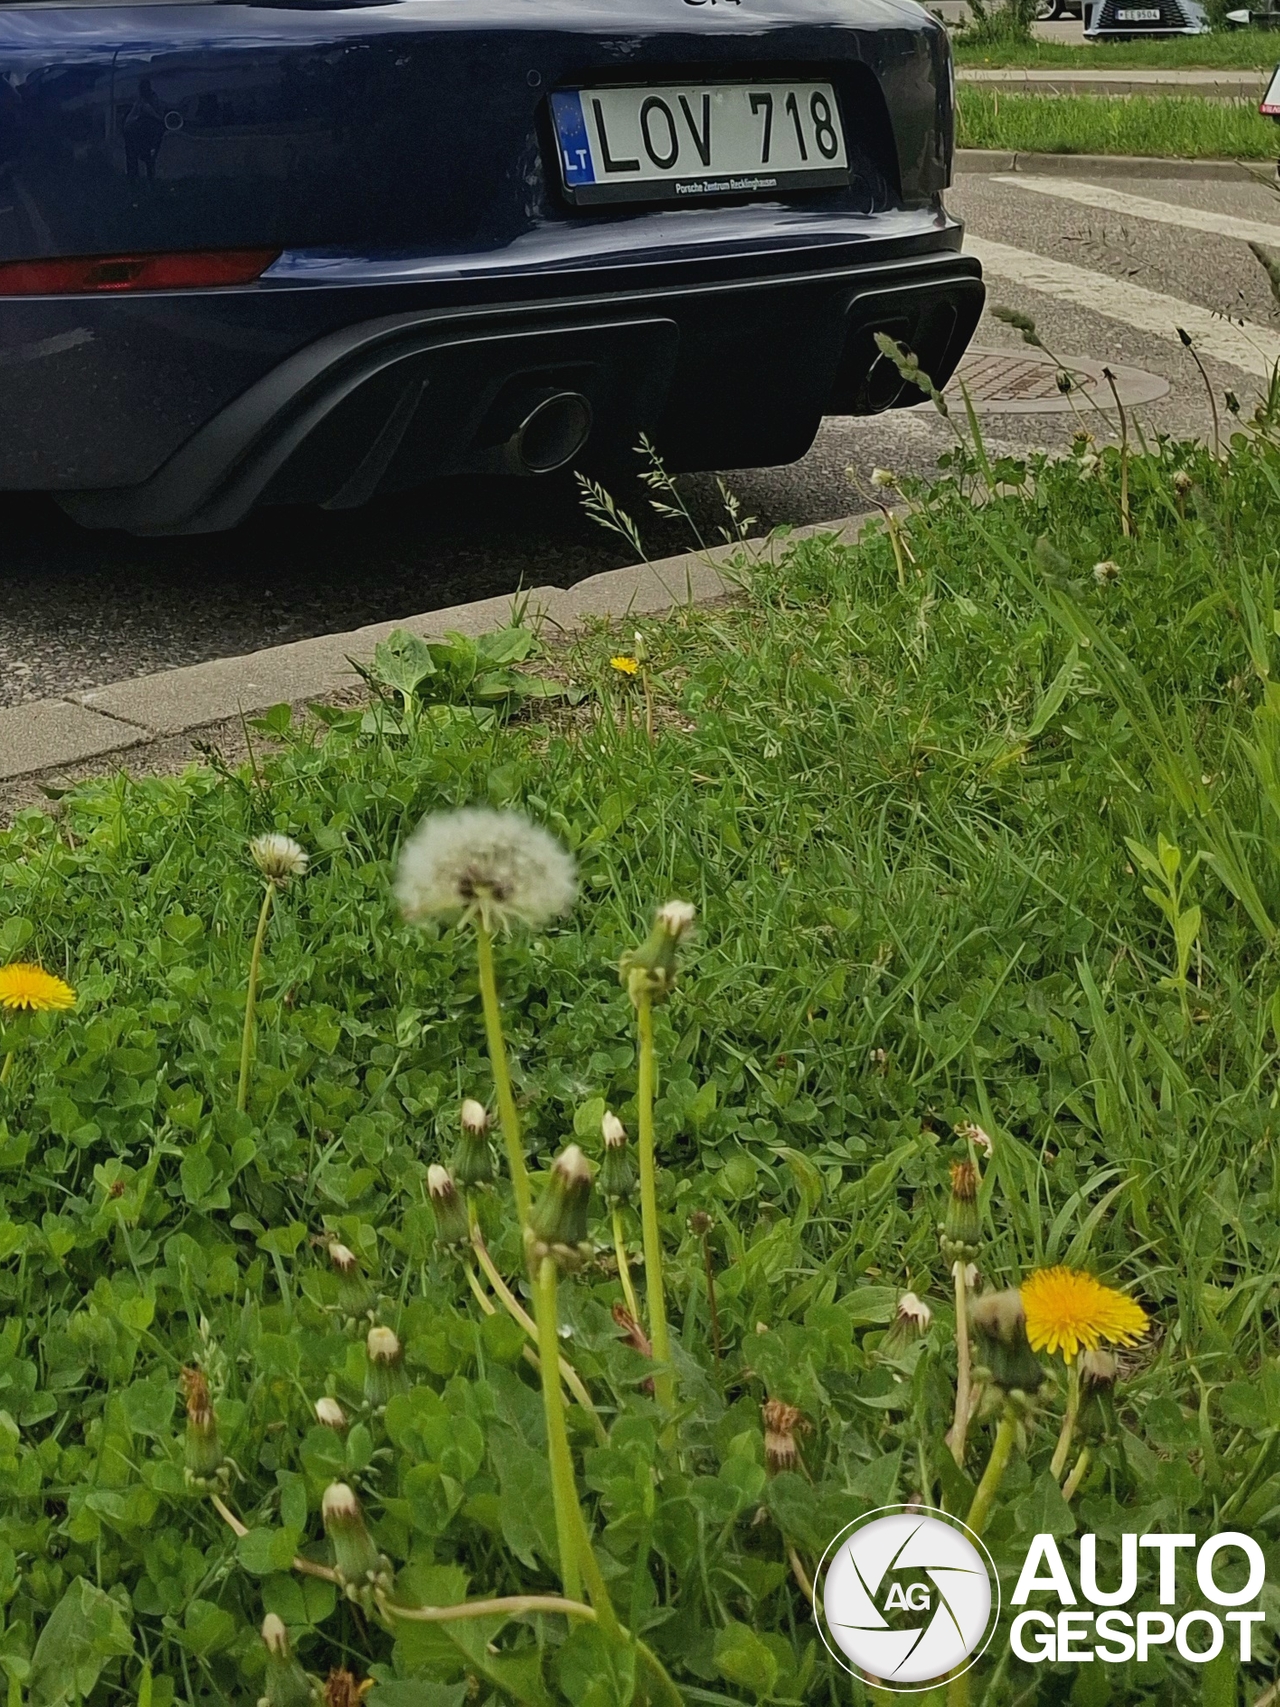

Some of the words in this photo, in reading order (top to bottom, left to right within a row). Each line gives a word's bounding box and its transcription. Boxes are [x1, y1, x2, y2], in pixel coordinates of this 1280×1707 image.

[591, 93, 711, 174] LOV
[748, 90, 839, 165] 718
[563, 149, 587, 171] LT
[675, 182, 703, 194] Porsche
[703, 181, 731, 192] Zentrum
[730, 177, 778, 191] Recklinghausen
